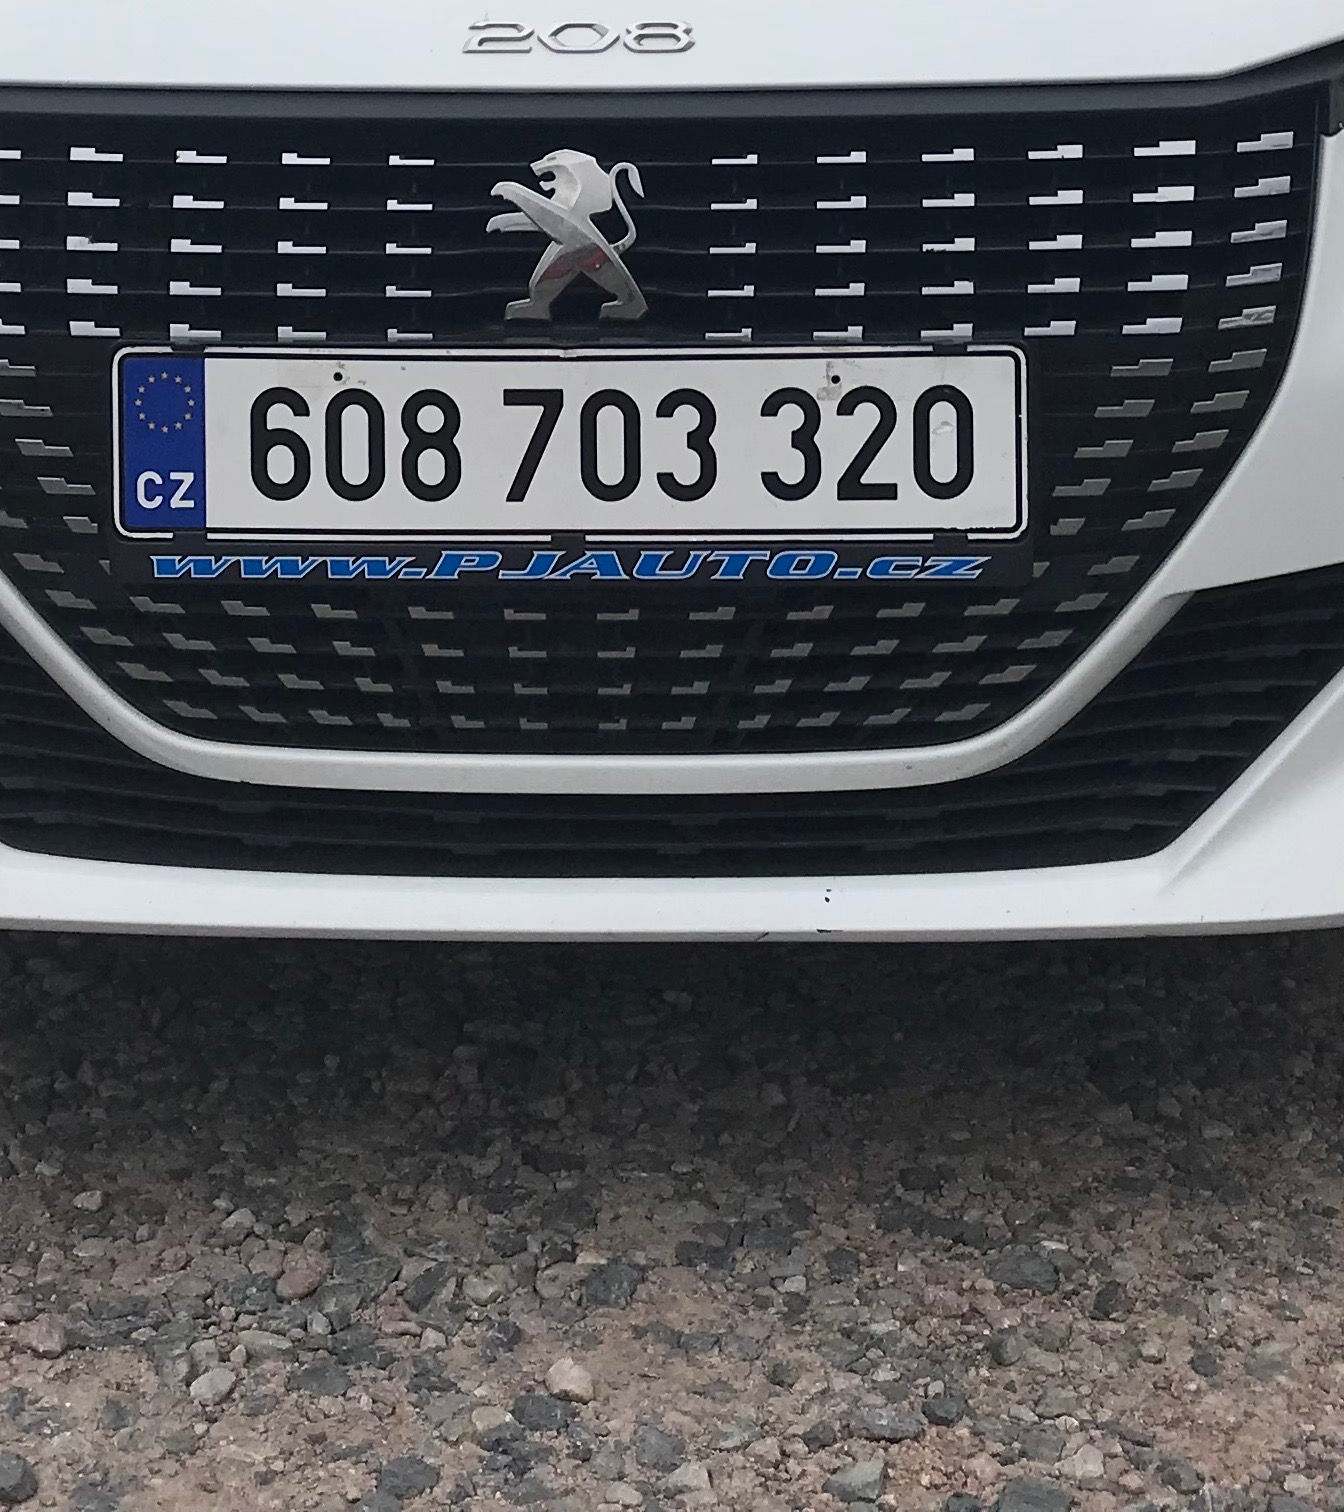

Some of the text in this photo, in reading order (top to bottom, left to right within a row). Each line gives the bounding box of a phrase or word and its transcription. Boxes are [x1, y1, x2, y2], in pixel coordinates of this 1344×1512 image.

[462, 21, 696, 54] 208
[136, 384, 974, 509] CZ 608 703 320
